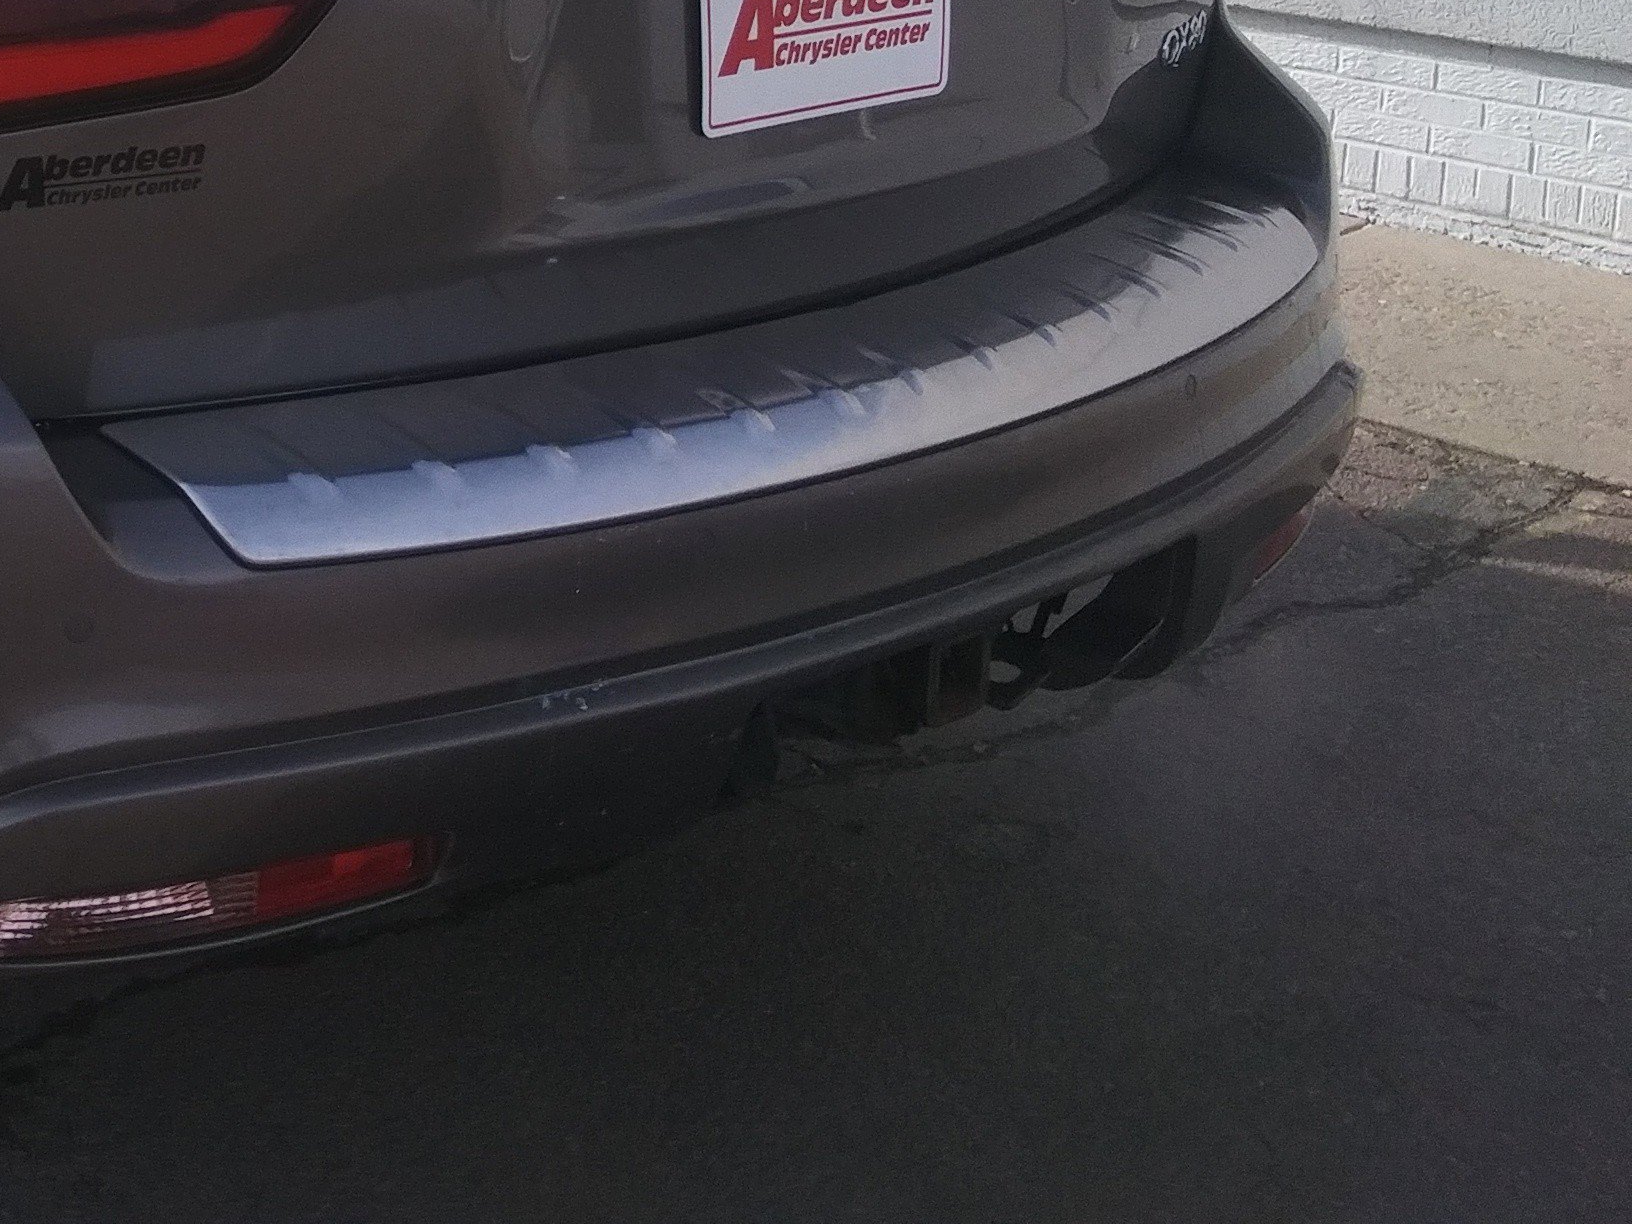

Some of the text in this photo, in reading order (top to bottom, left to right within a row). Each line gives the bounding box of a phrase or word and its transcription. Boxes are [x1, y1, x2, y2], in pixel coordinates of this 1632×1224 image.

[774, 20, 931, 67] Chrysler Center
[46, 176, 203, 207] Chrysler Center
